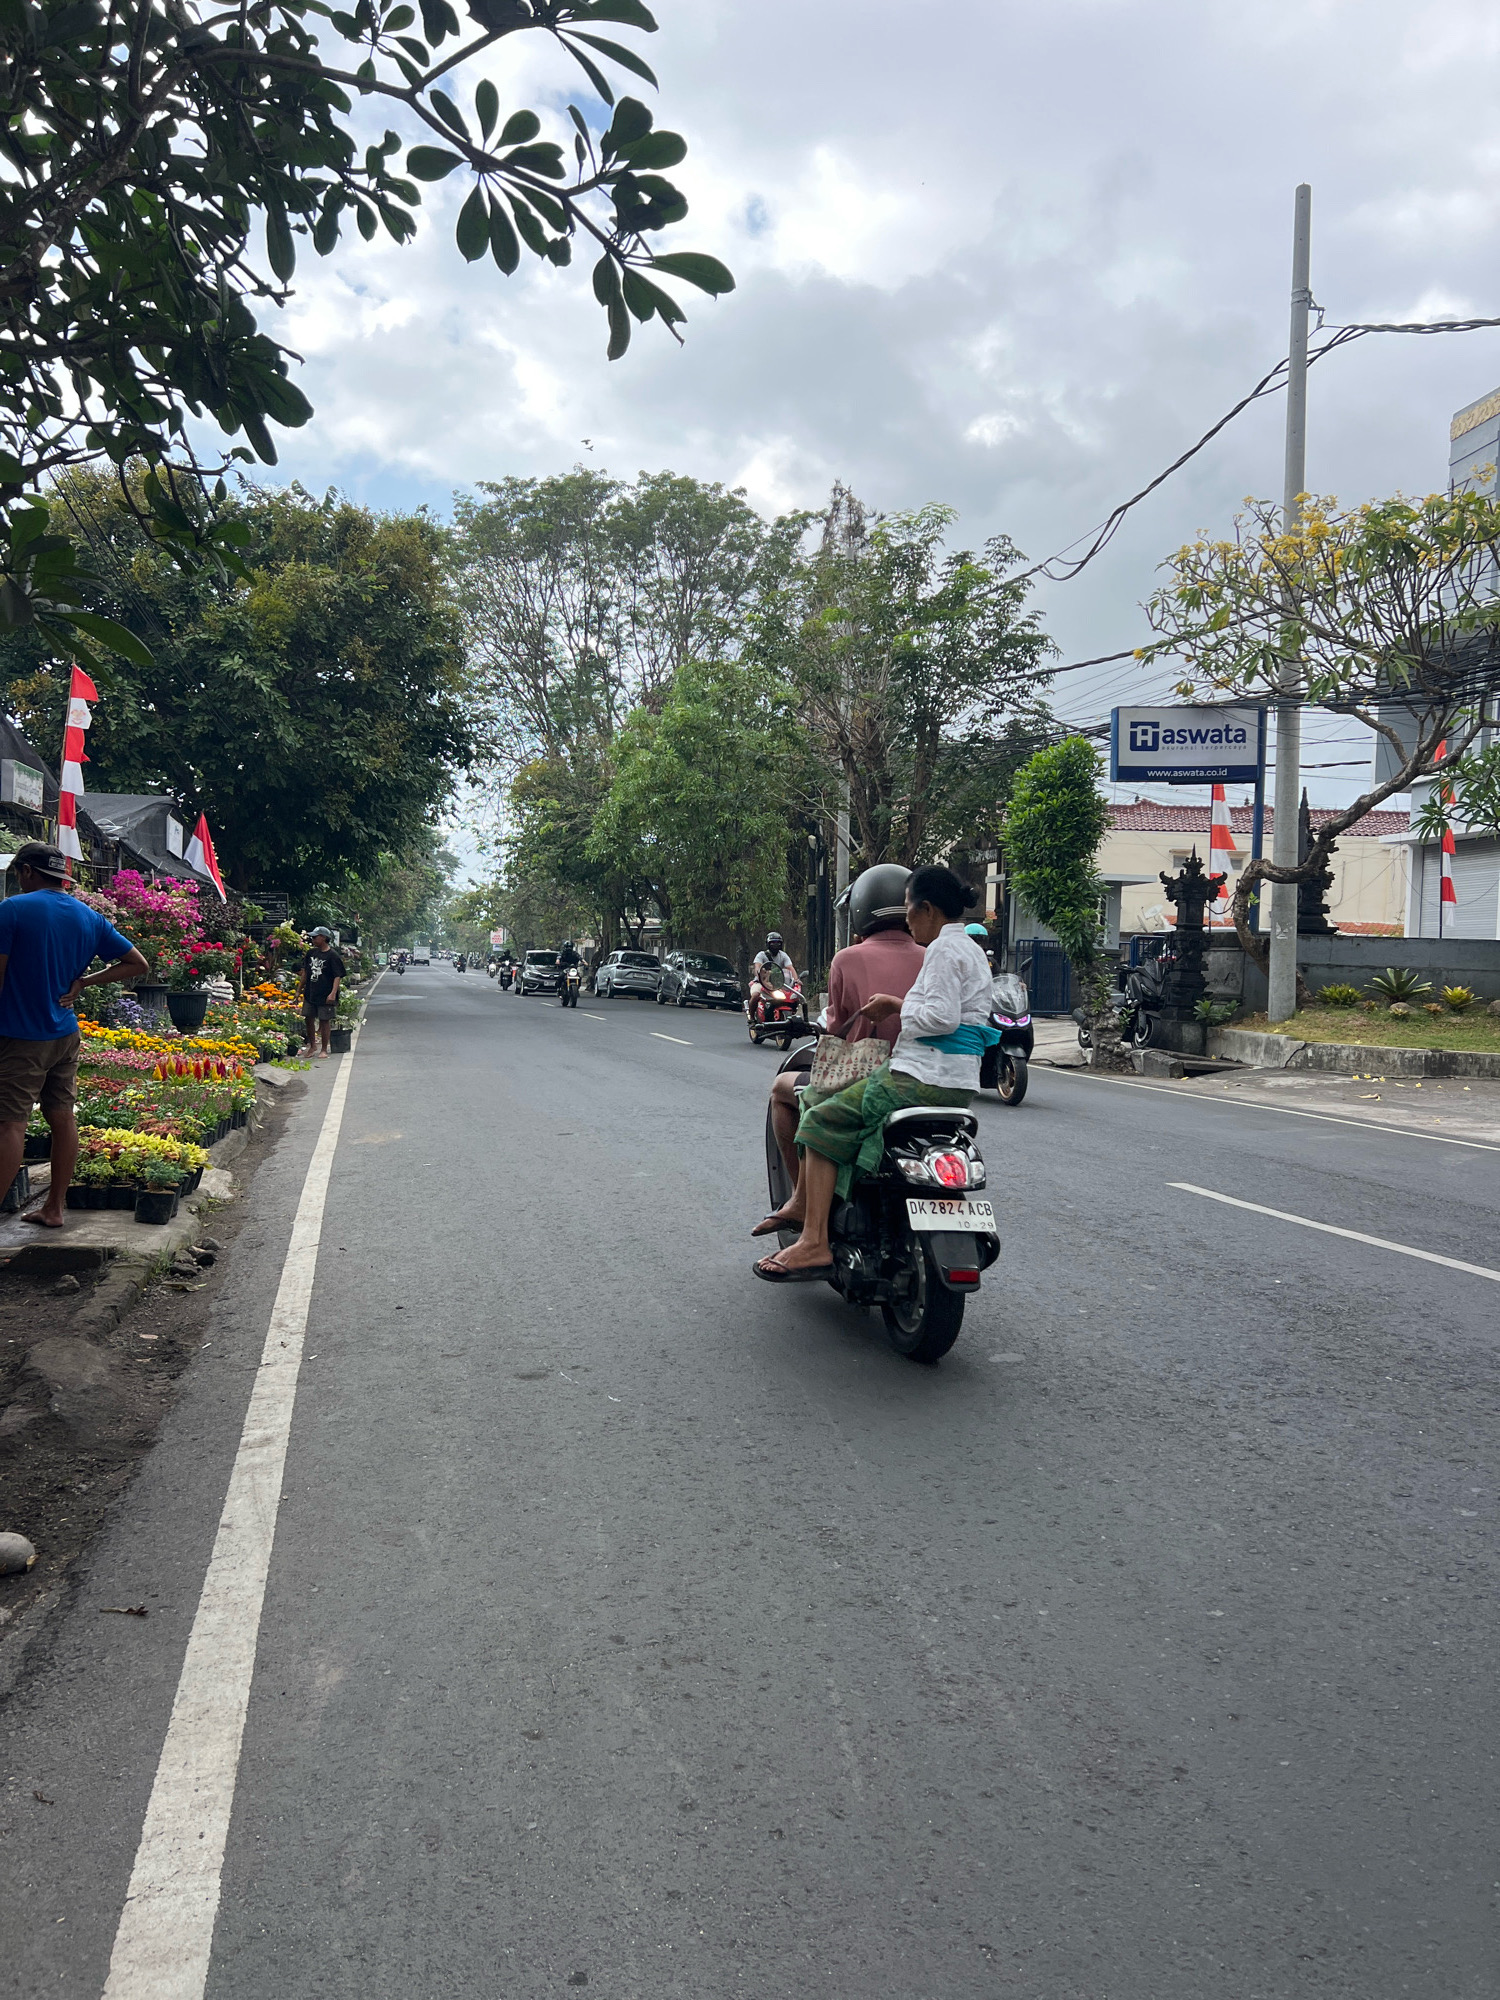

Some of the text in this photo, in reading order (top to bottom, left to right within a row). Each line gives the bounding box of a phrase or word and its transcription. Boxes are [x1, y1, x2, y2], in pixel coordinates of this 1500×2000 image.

[1162, 724, 1247, 744] aswata
[1147, 767, 1228, 777] www.aswata.co.id
[909, 1201, 993, 1216] DK 2824 ACB
